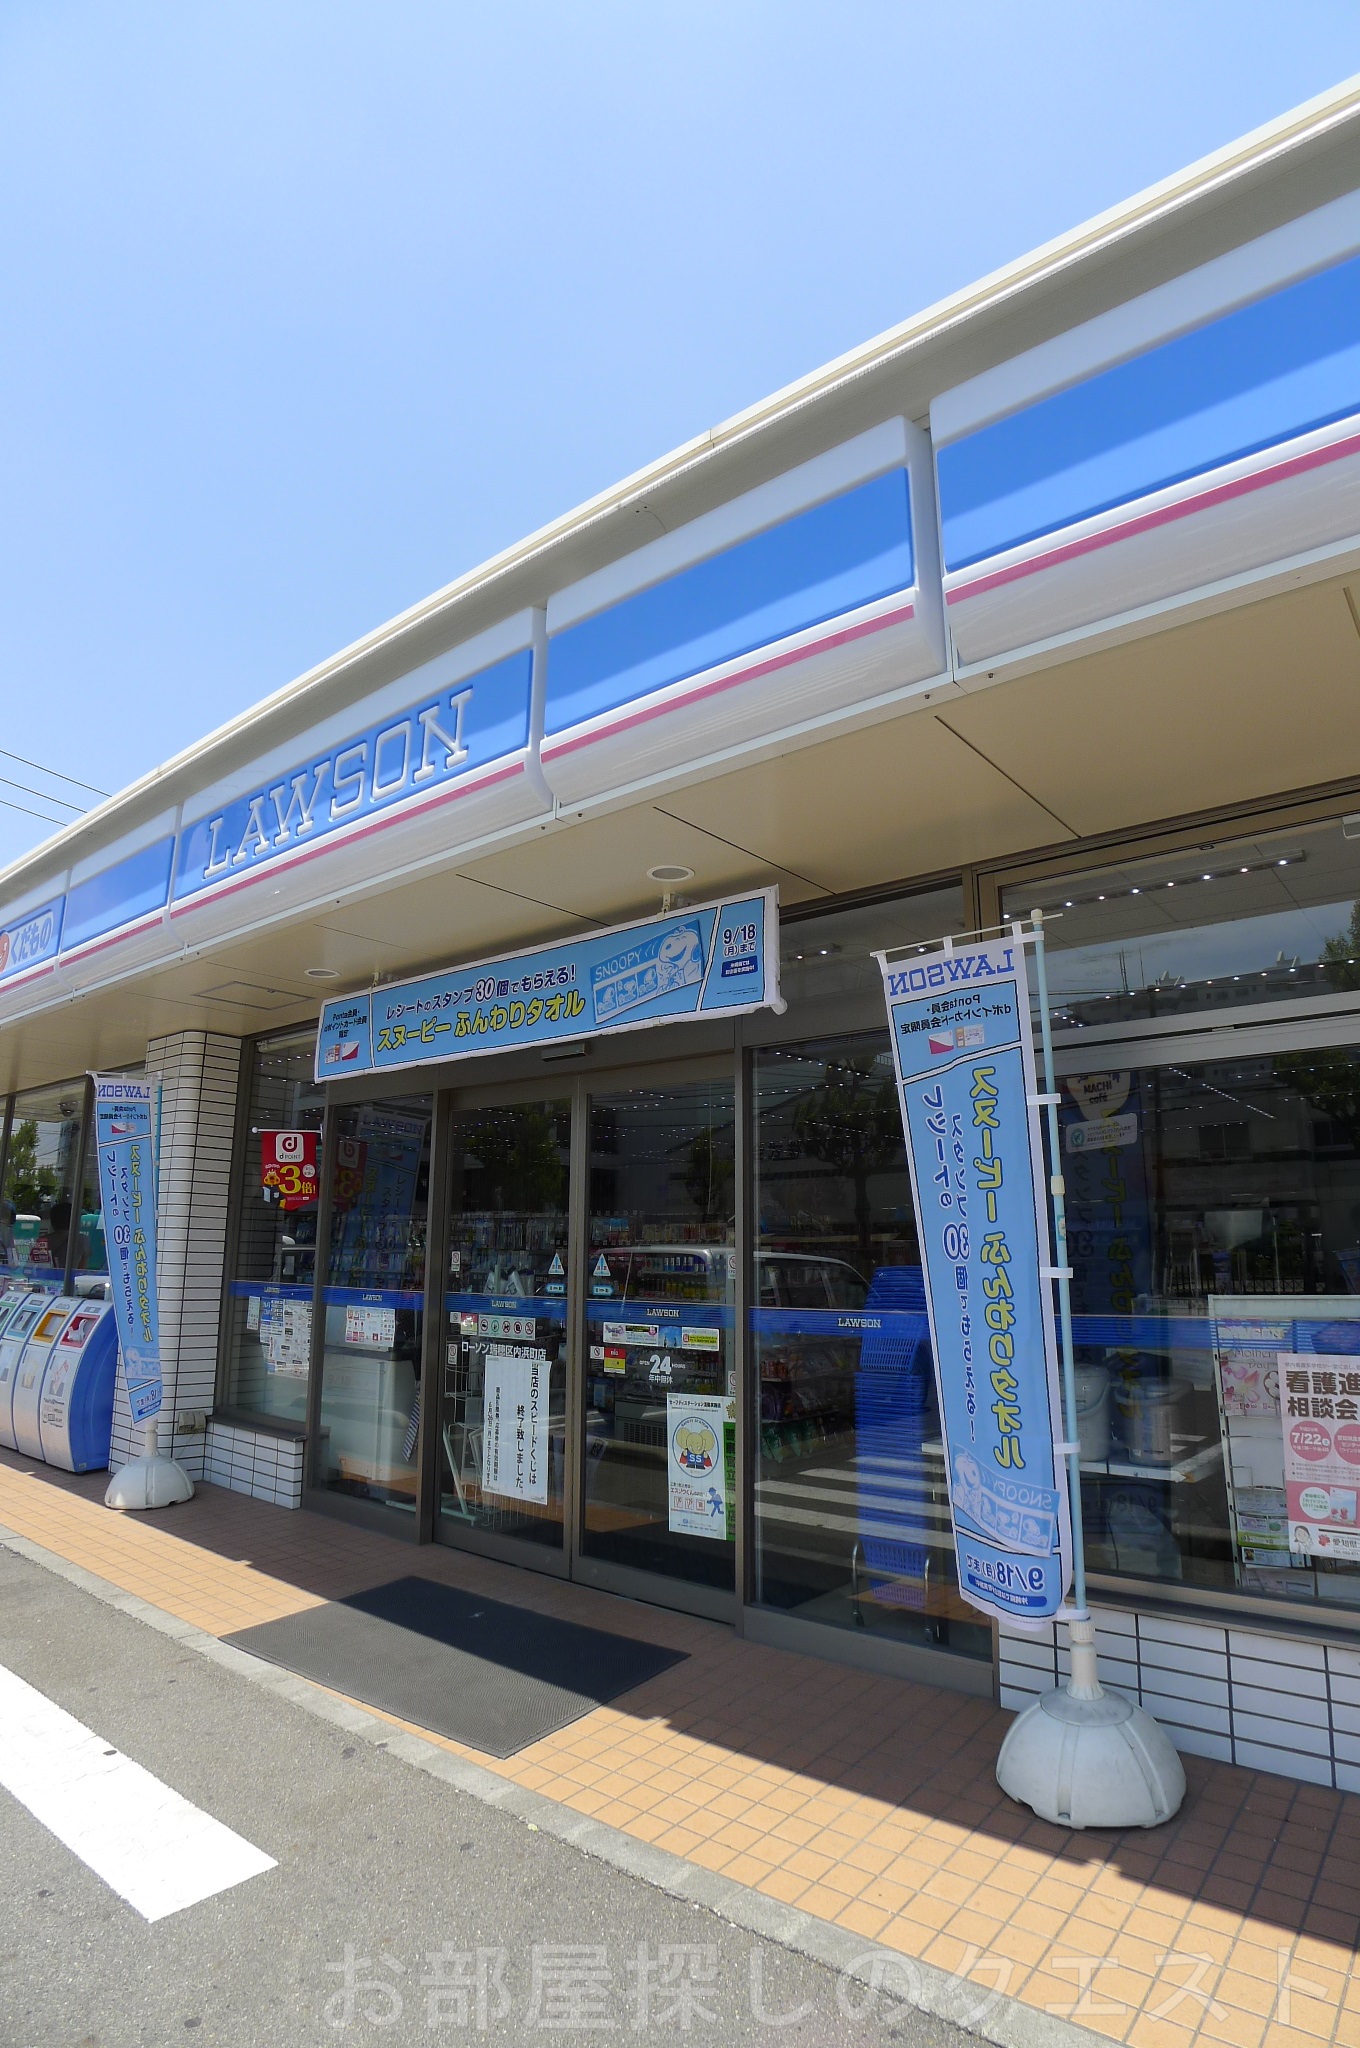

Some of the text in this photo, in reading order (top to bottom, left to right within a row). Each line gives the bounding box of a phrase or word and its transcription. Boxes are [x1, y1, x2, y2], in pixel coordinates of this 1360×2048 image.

[203, 687, 473, 879] LAWSON
[11, 917, 52, 964] くだもの
[723, 923, 756, 945] 9/18
[595, 950, 641, 982] SNOOPY
[377, 989, 585, 1052] スヌーピー ふんわりタオル
[1084, 1081, 1112, 1095] MACHI
[362, 1293, 383, 1302] LAWSON
[491, 1300, 517, 1309] LAWSON
[646, 1308, 680, 1318] LAWSON
[837, 1317, 882, 1328] LAWSON
[461, 1341, 547, 1362] ローソン瑞穂区内浜町店
[649, 1354, 672, 1375] 24
[1287, 1396, 1358, 1421] 相談会
[1291, 1431, 1322, 1446] 7/22
[689, 1454, 702, 1463] SS
